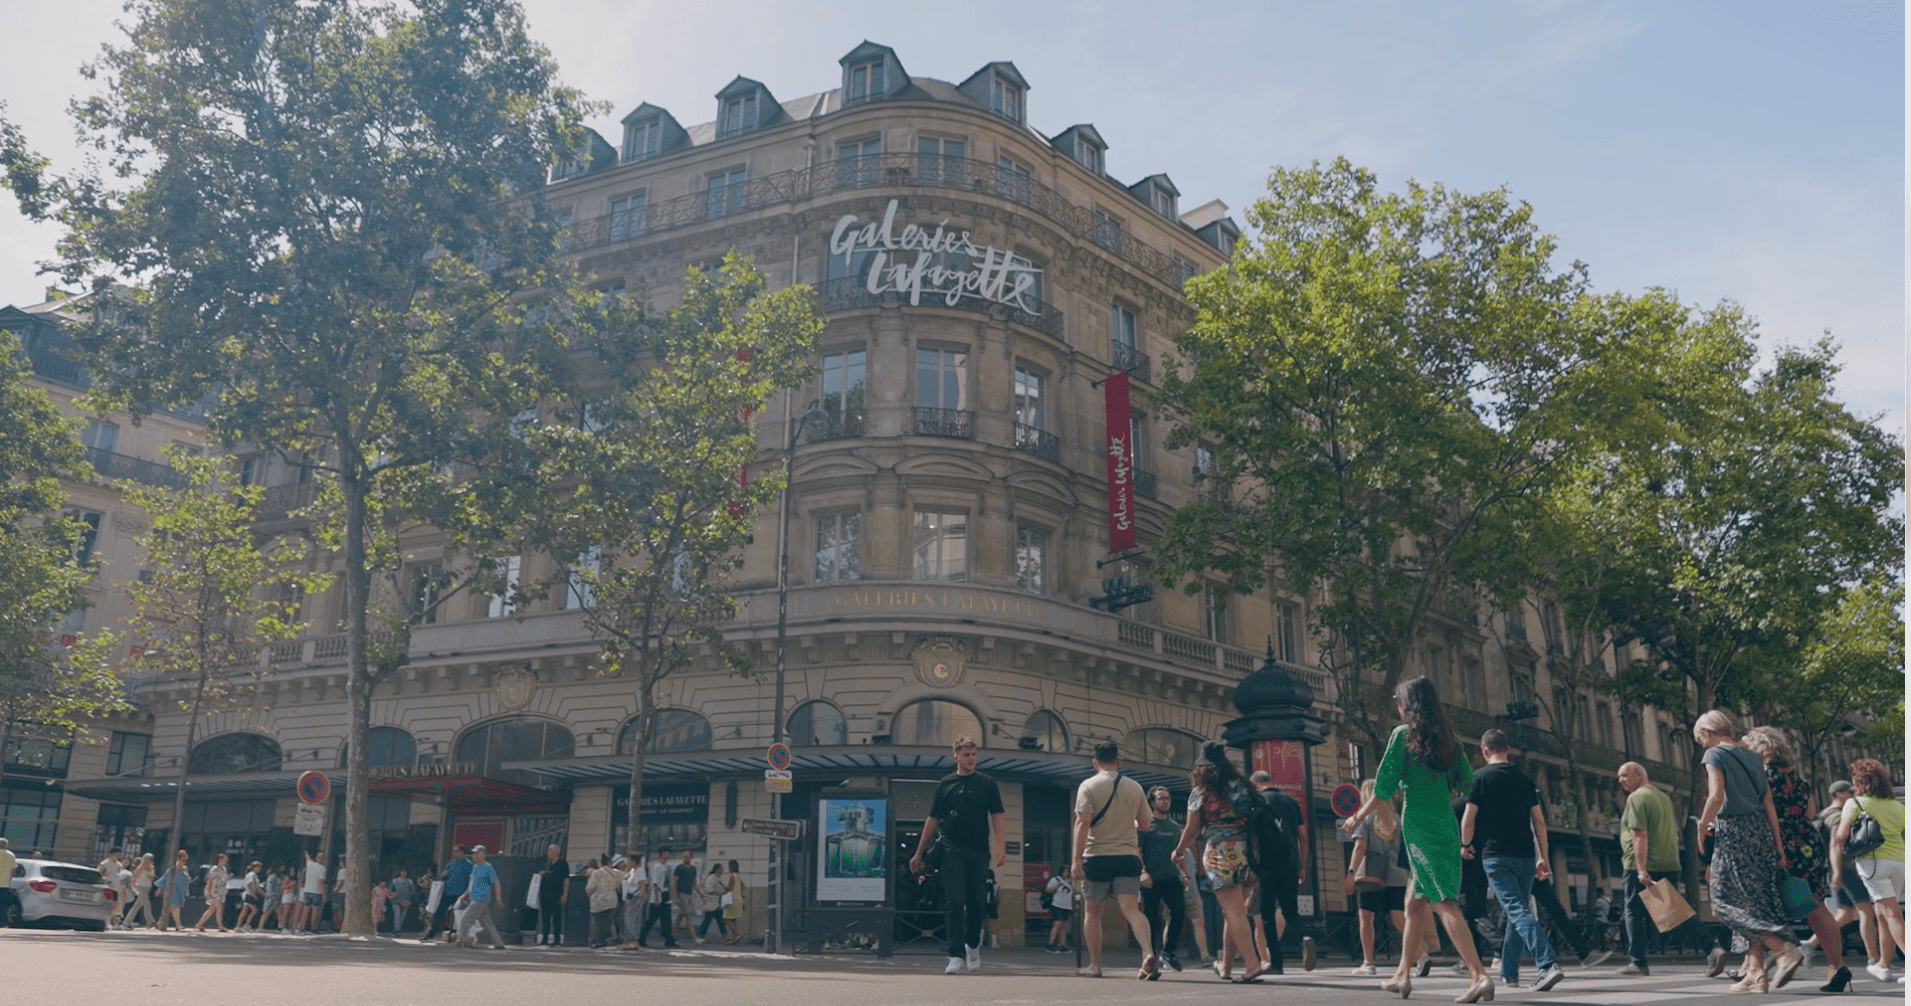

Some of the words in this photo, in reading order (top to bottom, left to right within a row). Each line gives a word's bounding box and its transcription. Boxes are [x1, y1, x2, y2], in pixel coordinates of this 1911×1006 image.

[830, 199, 978, 266] Galeries
[867, 246, 1044, 316] Lafayette
[836, 591, 935, 608] GALERIES
[942, 593, 1041, 618] LAFAYETTE
[617, 796, 658, 806] GARIES
[659, 795, 707, 805] LAFAYETTE
